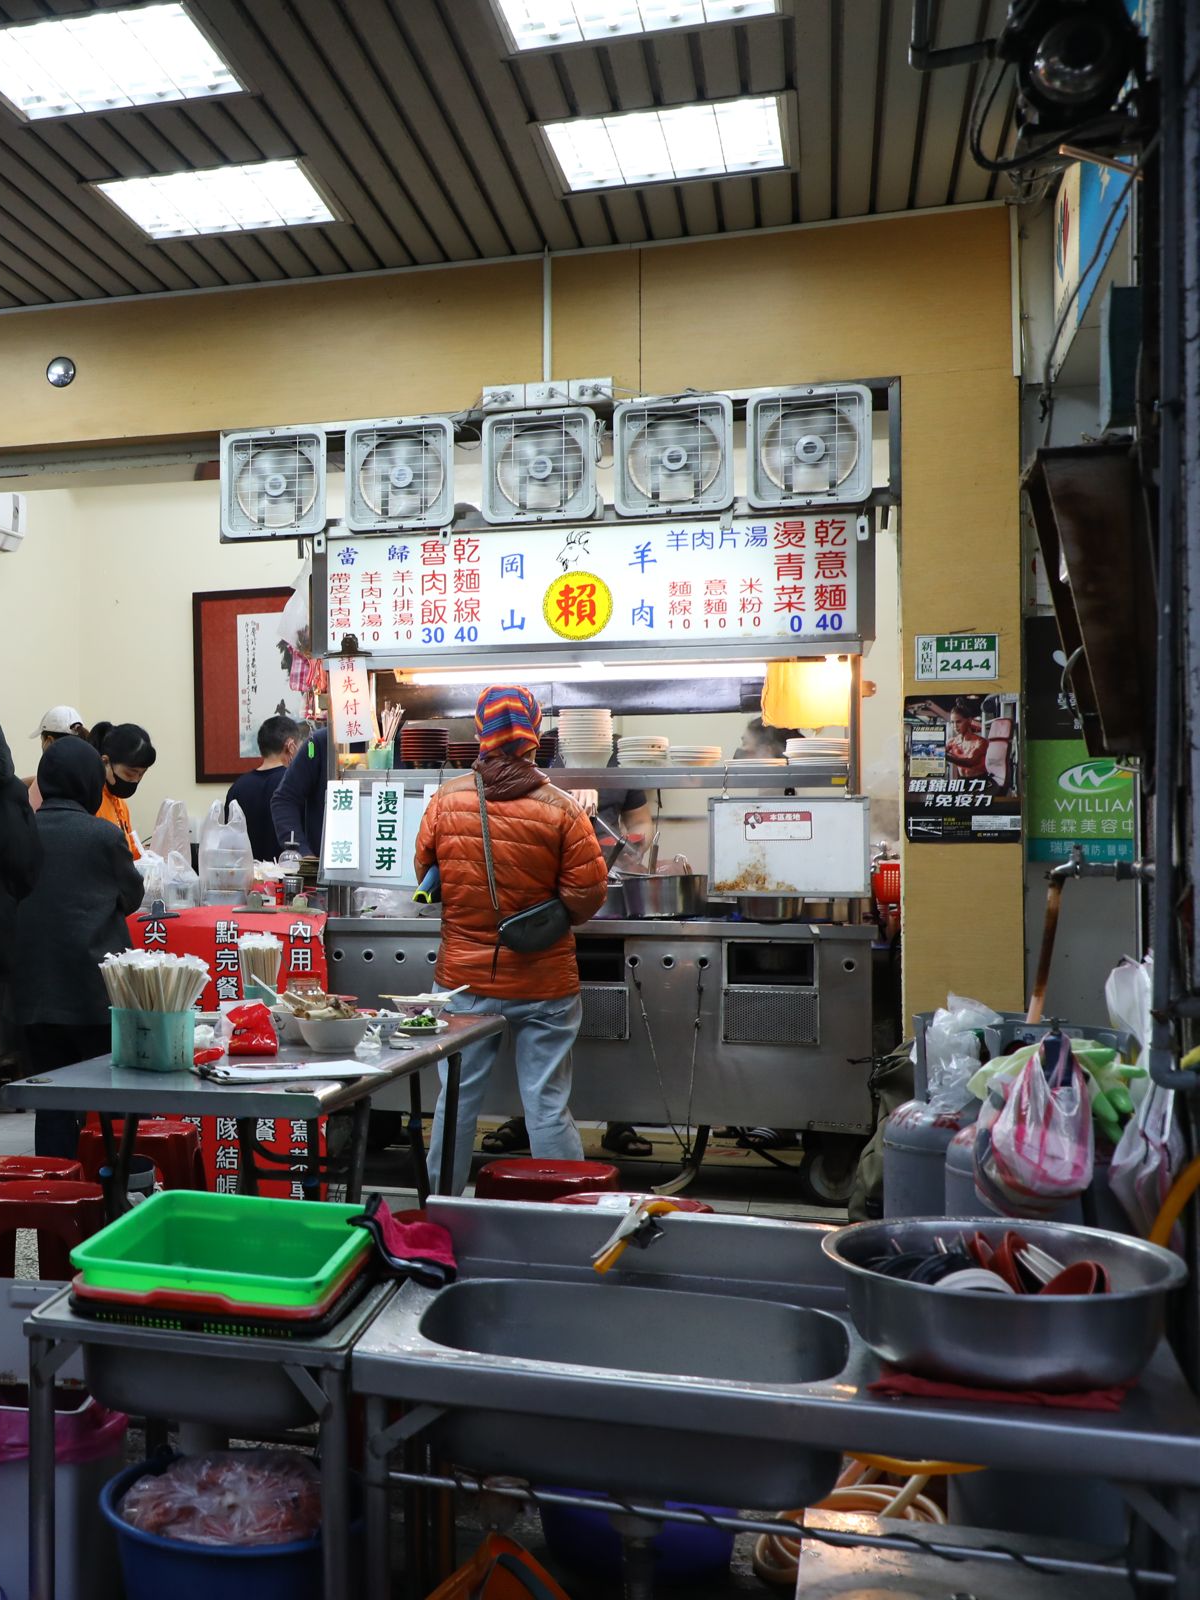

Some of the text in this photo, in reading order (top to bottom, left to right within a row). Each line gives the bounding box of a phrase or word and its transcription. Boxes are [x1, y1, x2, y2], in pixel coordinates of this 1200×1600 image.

[337, 545, 410, 565] 當歸
[666, 525, 768, 551] 羊肉片湯
[420, 540, 447, 625] 魯肉飯
[453, 538, 480, 623] 乾麵線
[628, 541, 657, 628] 羊肉
[774, 519, 806, 613] 燙青菜
[814, 519, 847, 612] 乾意麵
[330, 572, 351, 628] 帶皮羊肉湯
[361, 570, 382, 628] 羊肉片湯
[392, 570, 413, 626] 羊小排湯
[501, 554, 525, 631] 岡山
[555, 583, 596, 627] 賴
[668, 581, 692, 615] 麵線
[704, 579, 727, 615] 意麵
[739, 577, 763, 613] 米粉
[421, 627, 445, 643] 30
[454, 626, 478, 642] 40
[790, 615, 803, 632] 0
[815, 613, 842, 631] 40
[945, 638, 987, 651] 中正路
[921, 641, 933, 674] 新店區
[940, 659, 991, 672] 244-4
[339, 657, 363, 737] 請先付款
[935, 794, 992, 807] 免疫力
[331, 789, 353, 863] 菠菜
[375, 790, 398, 871] 燙豆芽
[216, 921, 239, 999] 點完餐
[216, 1118, 239, 1194] 隊結帳
